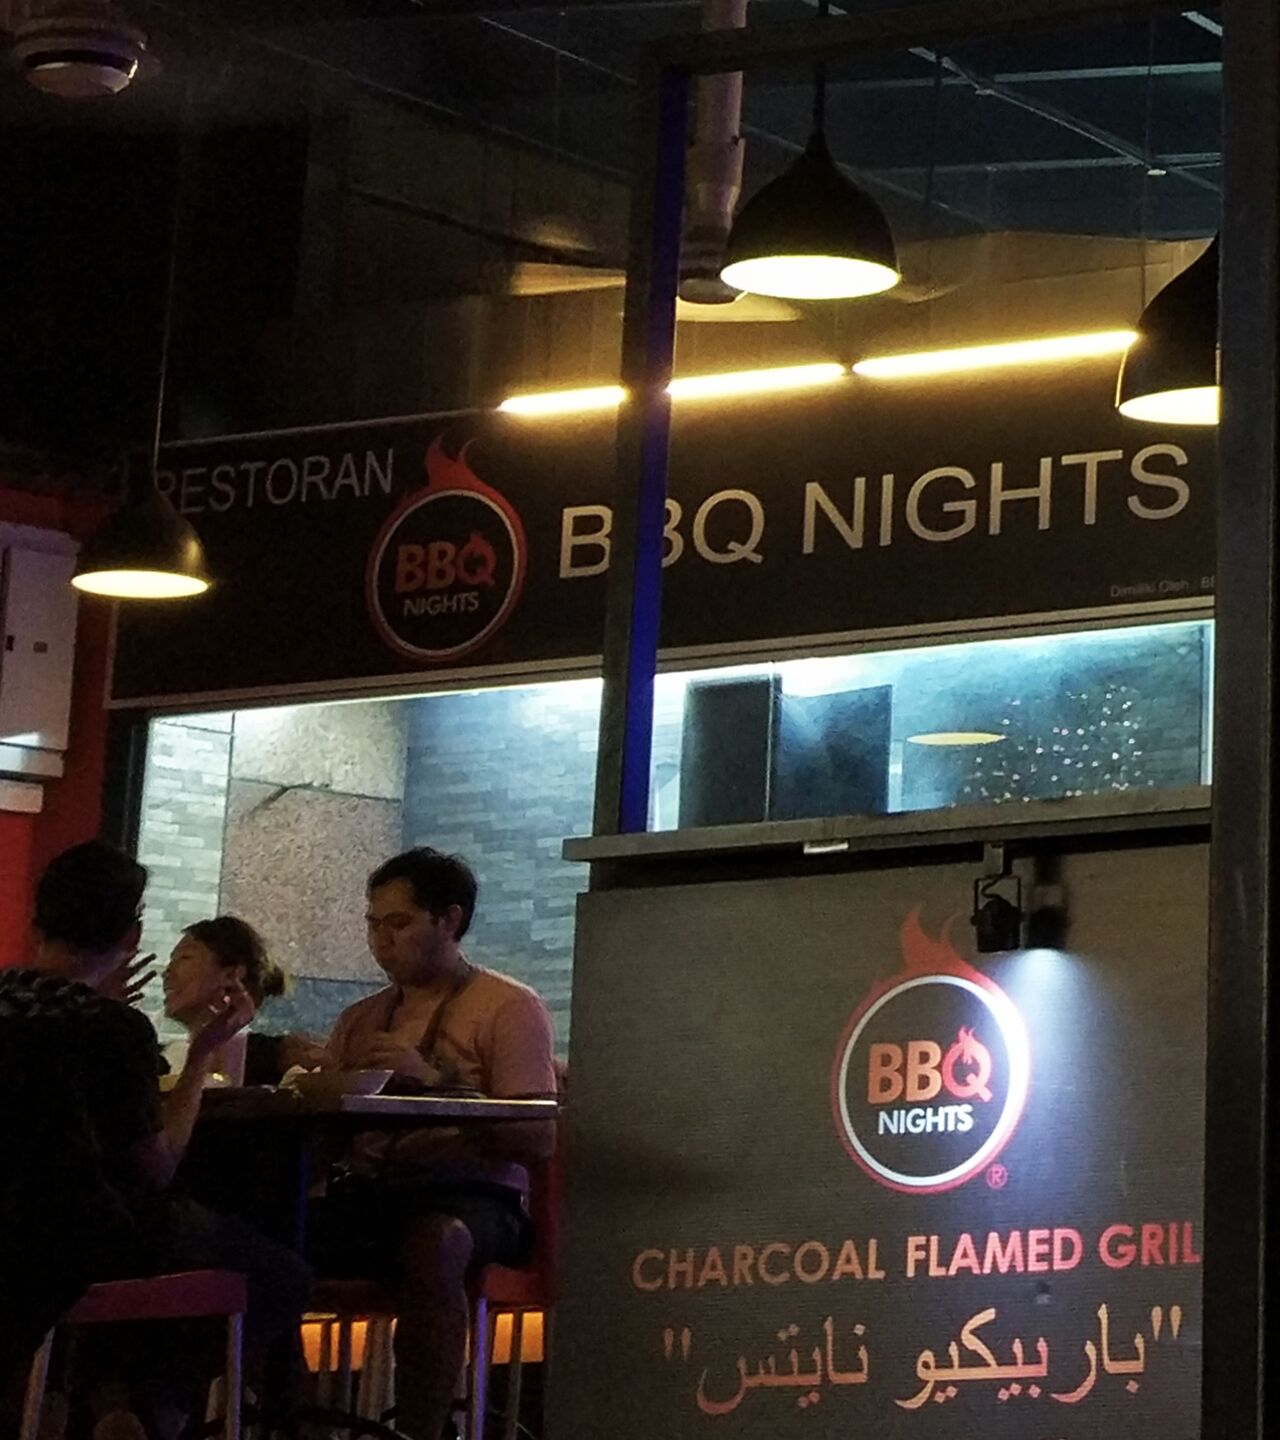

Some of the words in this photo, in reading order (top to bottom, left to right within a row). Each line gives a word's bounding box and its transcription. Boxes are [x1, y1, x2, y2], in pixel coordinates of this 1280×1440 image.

[154, 447, 394, 515] RESTORAN
[802, 442, 1192, 555] NIGHTS
[395, 531, 497, 592] BBQ
[404, 590, 479, 617] NIGHTS
[867, 1024, 993, 1105] BBQ
[878, 1103, 975, 1135] NIGHTS
[631, 1237, 886, 1291] CHARCOAL
[905, 1227, 1084, 1278] FLAMED
[1098, 1219, 1202, 1270] GRIL
